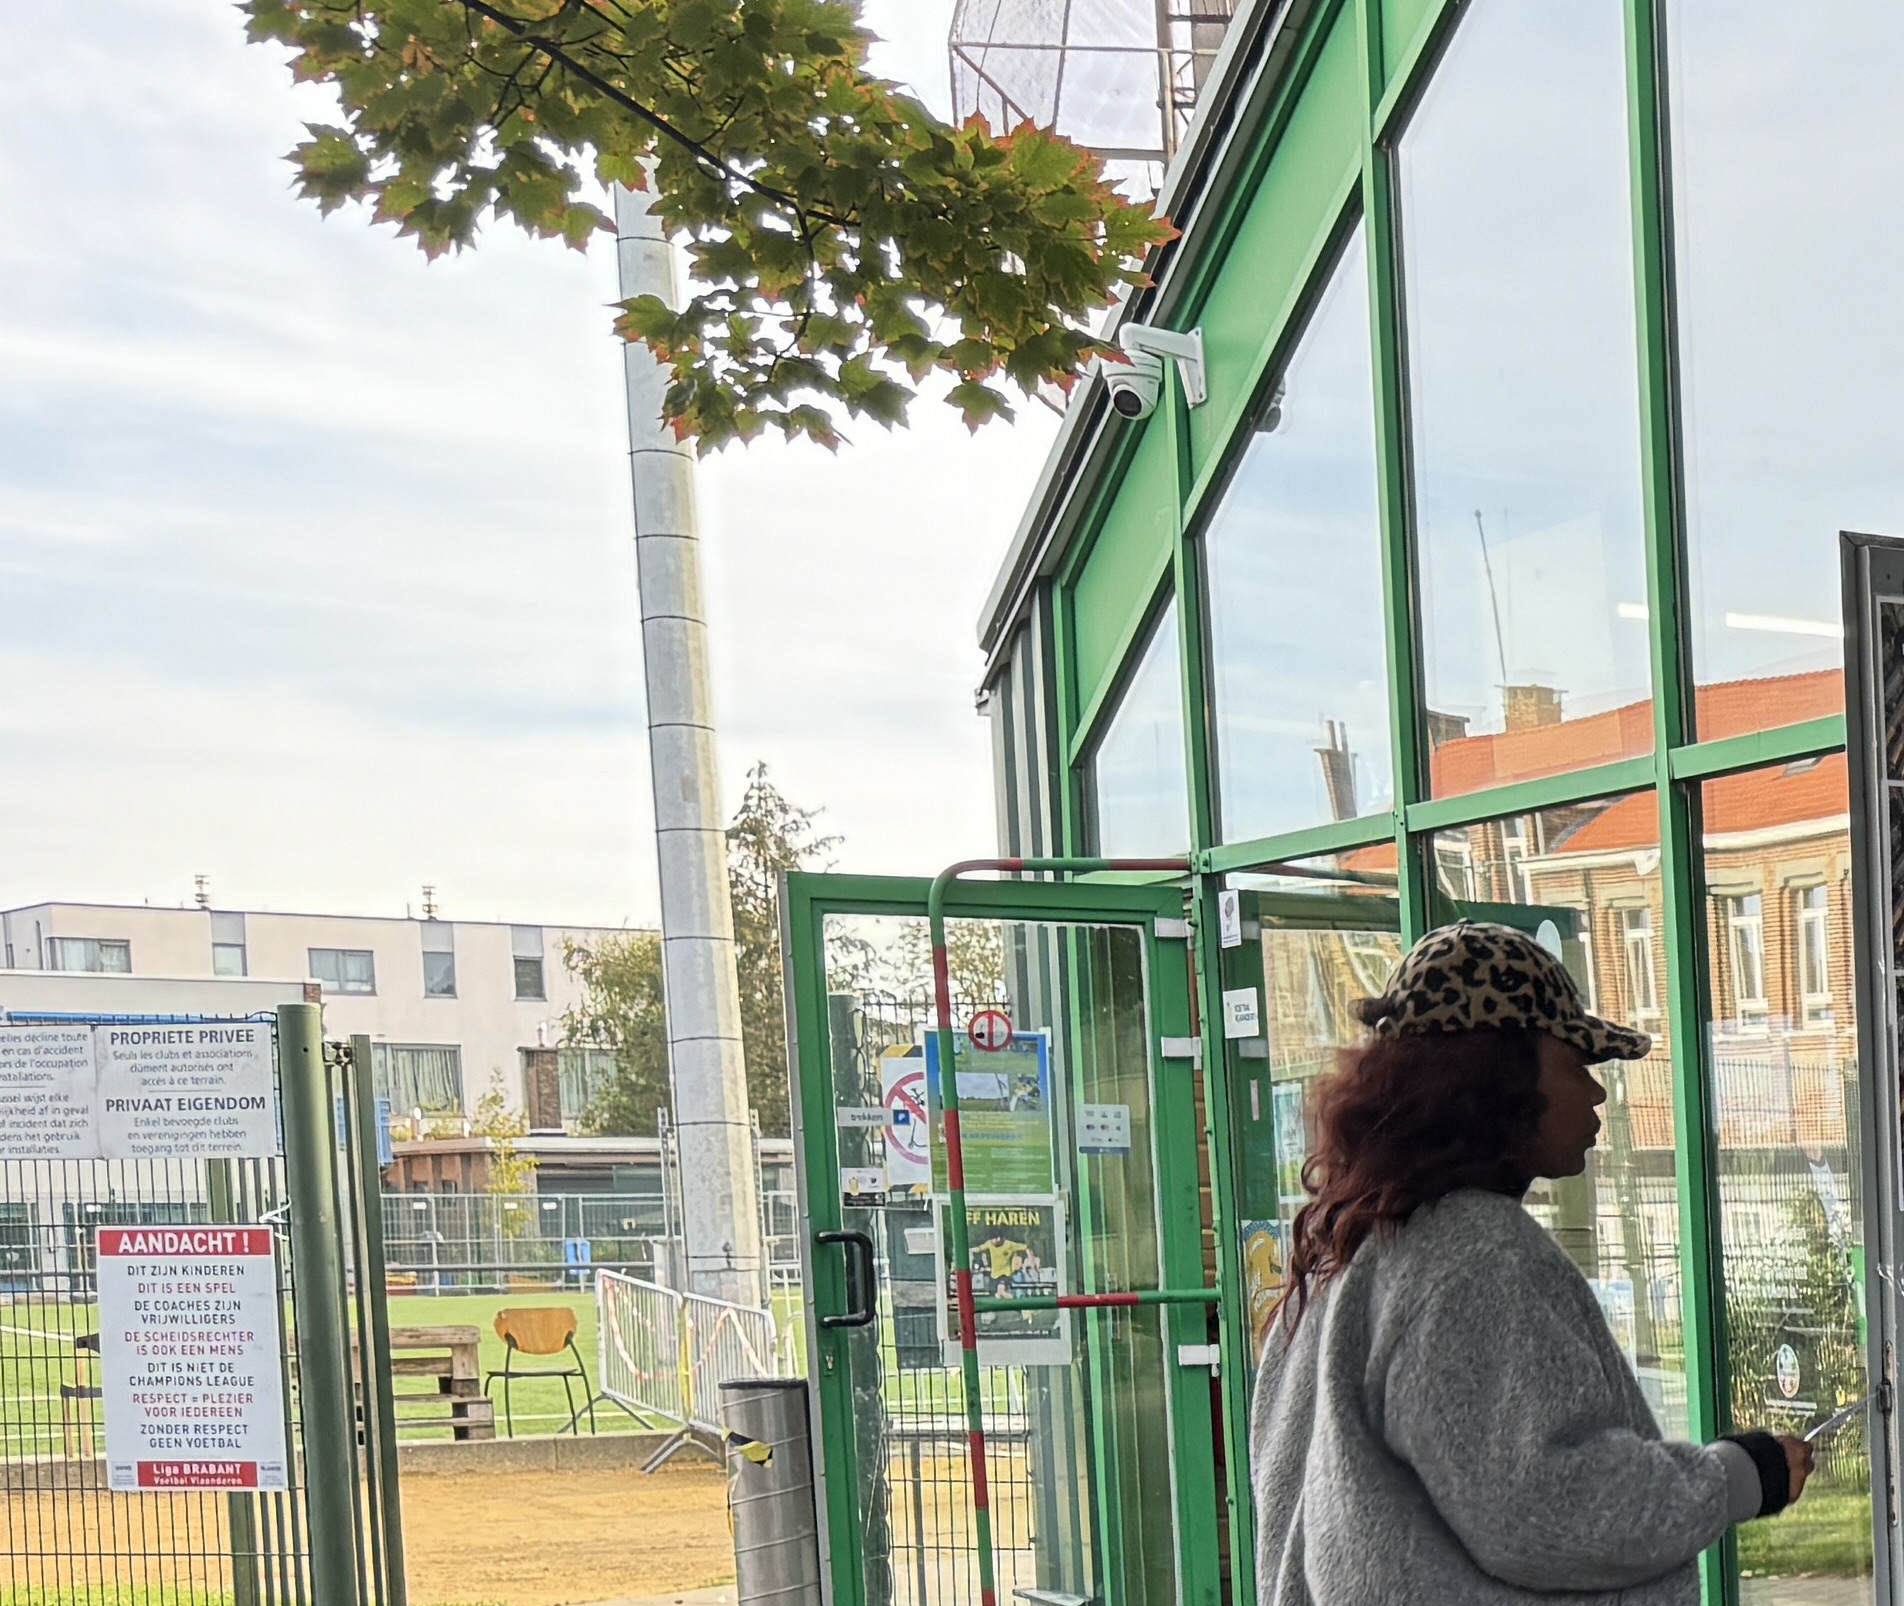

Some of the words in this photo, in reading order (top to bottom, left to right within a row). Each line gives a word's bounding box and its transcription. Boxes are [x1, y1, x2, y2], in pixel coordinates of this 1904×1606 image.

[110, 1030, 194, 1045] PROPRIETE
[199, 1029, 255, 1044] PRIVEE
[113, 1050, 138, 1061] Seuls
[140, 1050, 152, 1060] les
[155, 1049, 180, 1060] clubs
[182, 1050, 193, 1060] et
[216, 1063, 234, 1071] ont
[169, 1076, 175, 1085] à
[177, 1077, 188, 1086] ce
[106, 1098, 173, 1112] PRIVAAT
[178, 1096, 266, 1111] EIGENDOM
[134, 1117, 161, 1127] Enkel
[163, 1116, 212, 1128] bevoegde
[214, 1116, 239, 1126] clubs
[128, 1131, 140, 1140] en
[143, 1131, 207, 1142] verenigingen
[210, 1129, 247, 1139] hebben
[131, 1143, 172, 1155] toegang
[174, 1143, 189, 1152] tot
[192, 1143, 206, 1152] dit
[985, 1212, 1040, 1226] HAREN
[118, 1231, 237, 1254] AANDACHT
[242, 1231, 250, 1253] !
[127, 1265, 147, 1276] DIT
[150, 1265, 178, 1276] ZIJN
[181, 1265, 245, 1276] KINDEREN
[138, 1282, 158, 1294] DIT
[161, 1282, 173, 1294] IS
[177, 1282, 201, 1294] EEN
[205, 1282, 236, 1294] SPEL
[134, 1300, 150, 1311] DE
[154, 1300, 211, 1311] COACHES
[214, 1300, 241, 1311] ZIJN
[141, 1313, 236, 1325] VRIJWILLIGERS
[124, 1331, 140, 1342] DE
[144, 1331, 254, 1342] SCHEIDSRECHTER
[136, 1345, 147, 1356] IS
[152, 1345, 177, 1356] OOK
[181, 1345, 205, 1356] EEN
[209, 1345, 244, 1356] MENS
[147, 1362, 167, 1373] DIT
[171, 1362, 183, 1373] IS
[187, 1362, 215, 1373] NIET
[220, 1362, 235, 1373] DE
[129, 1375, 203, 1387] CHAMPIONS
[206, 1375, 254, 1387] LEAGUE
[133, 1393, 188, 1404] RESPECT
[202, 1393, 254, 1404] PLEZIER
[144, 1406, 177, 1418] VOOR
[181, 1406, 243, 1418] IEDEREEN
[140, 1424, 190, 1435] ZONDER
[194, 1424, 248, 1435] RESPECT
[150, 1438, 182, 1449] GEEN
[186, 1438, 242, 1449] VOETBAL
[152, 1463, 179, 1476] Liga
[183, 1463, 242, 1475] BRABANT
[154, 1476, 188, 1485] Voetbal
[190, 1476, 243, 1485] Vlaanderen
